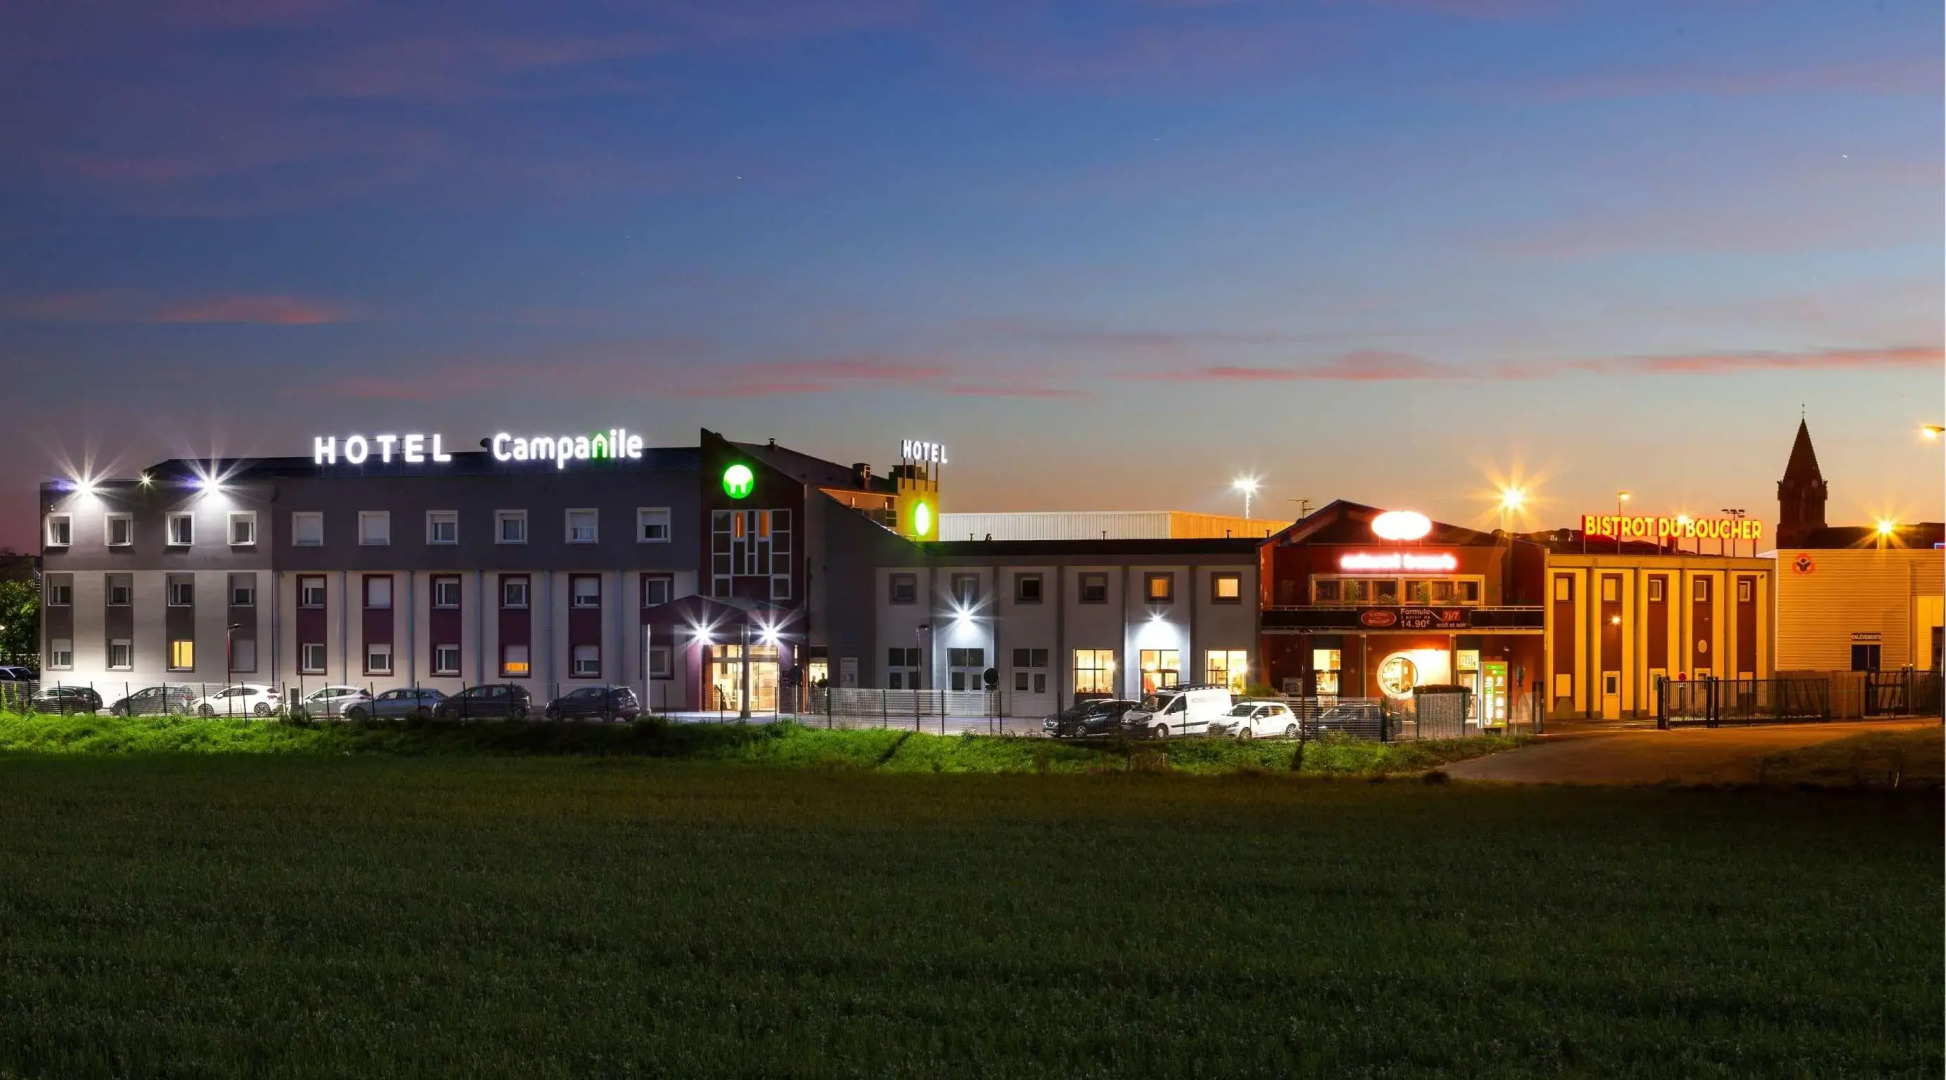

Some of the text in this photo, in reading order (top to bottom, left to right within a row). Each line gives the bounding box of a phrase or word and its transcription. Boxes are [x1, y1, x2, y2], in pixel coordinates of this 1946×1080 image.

[314, 429, 643, 469] HOTEL Campanile
[902, 439, 948, 464] HOTEL
[1584, 515, 1762, 539] BISTROT DU BOUCHER
